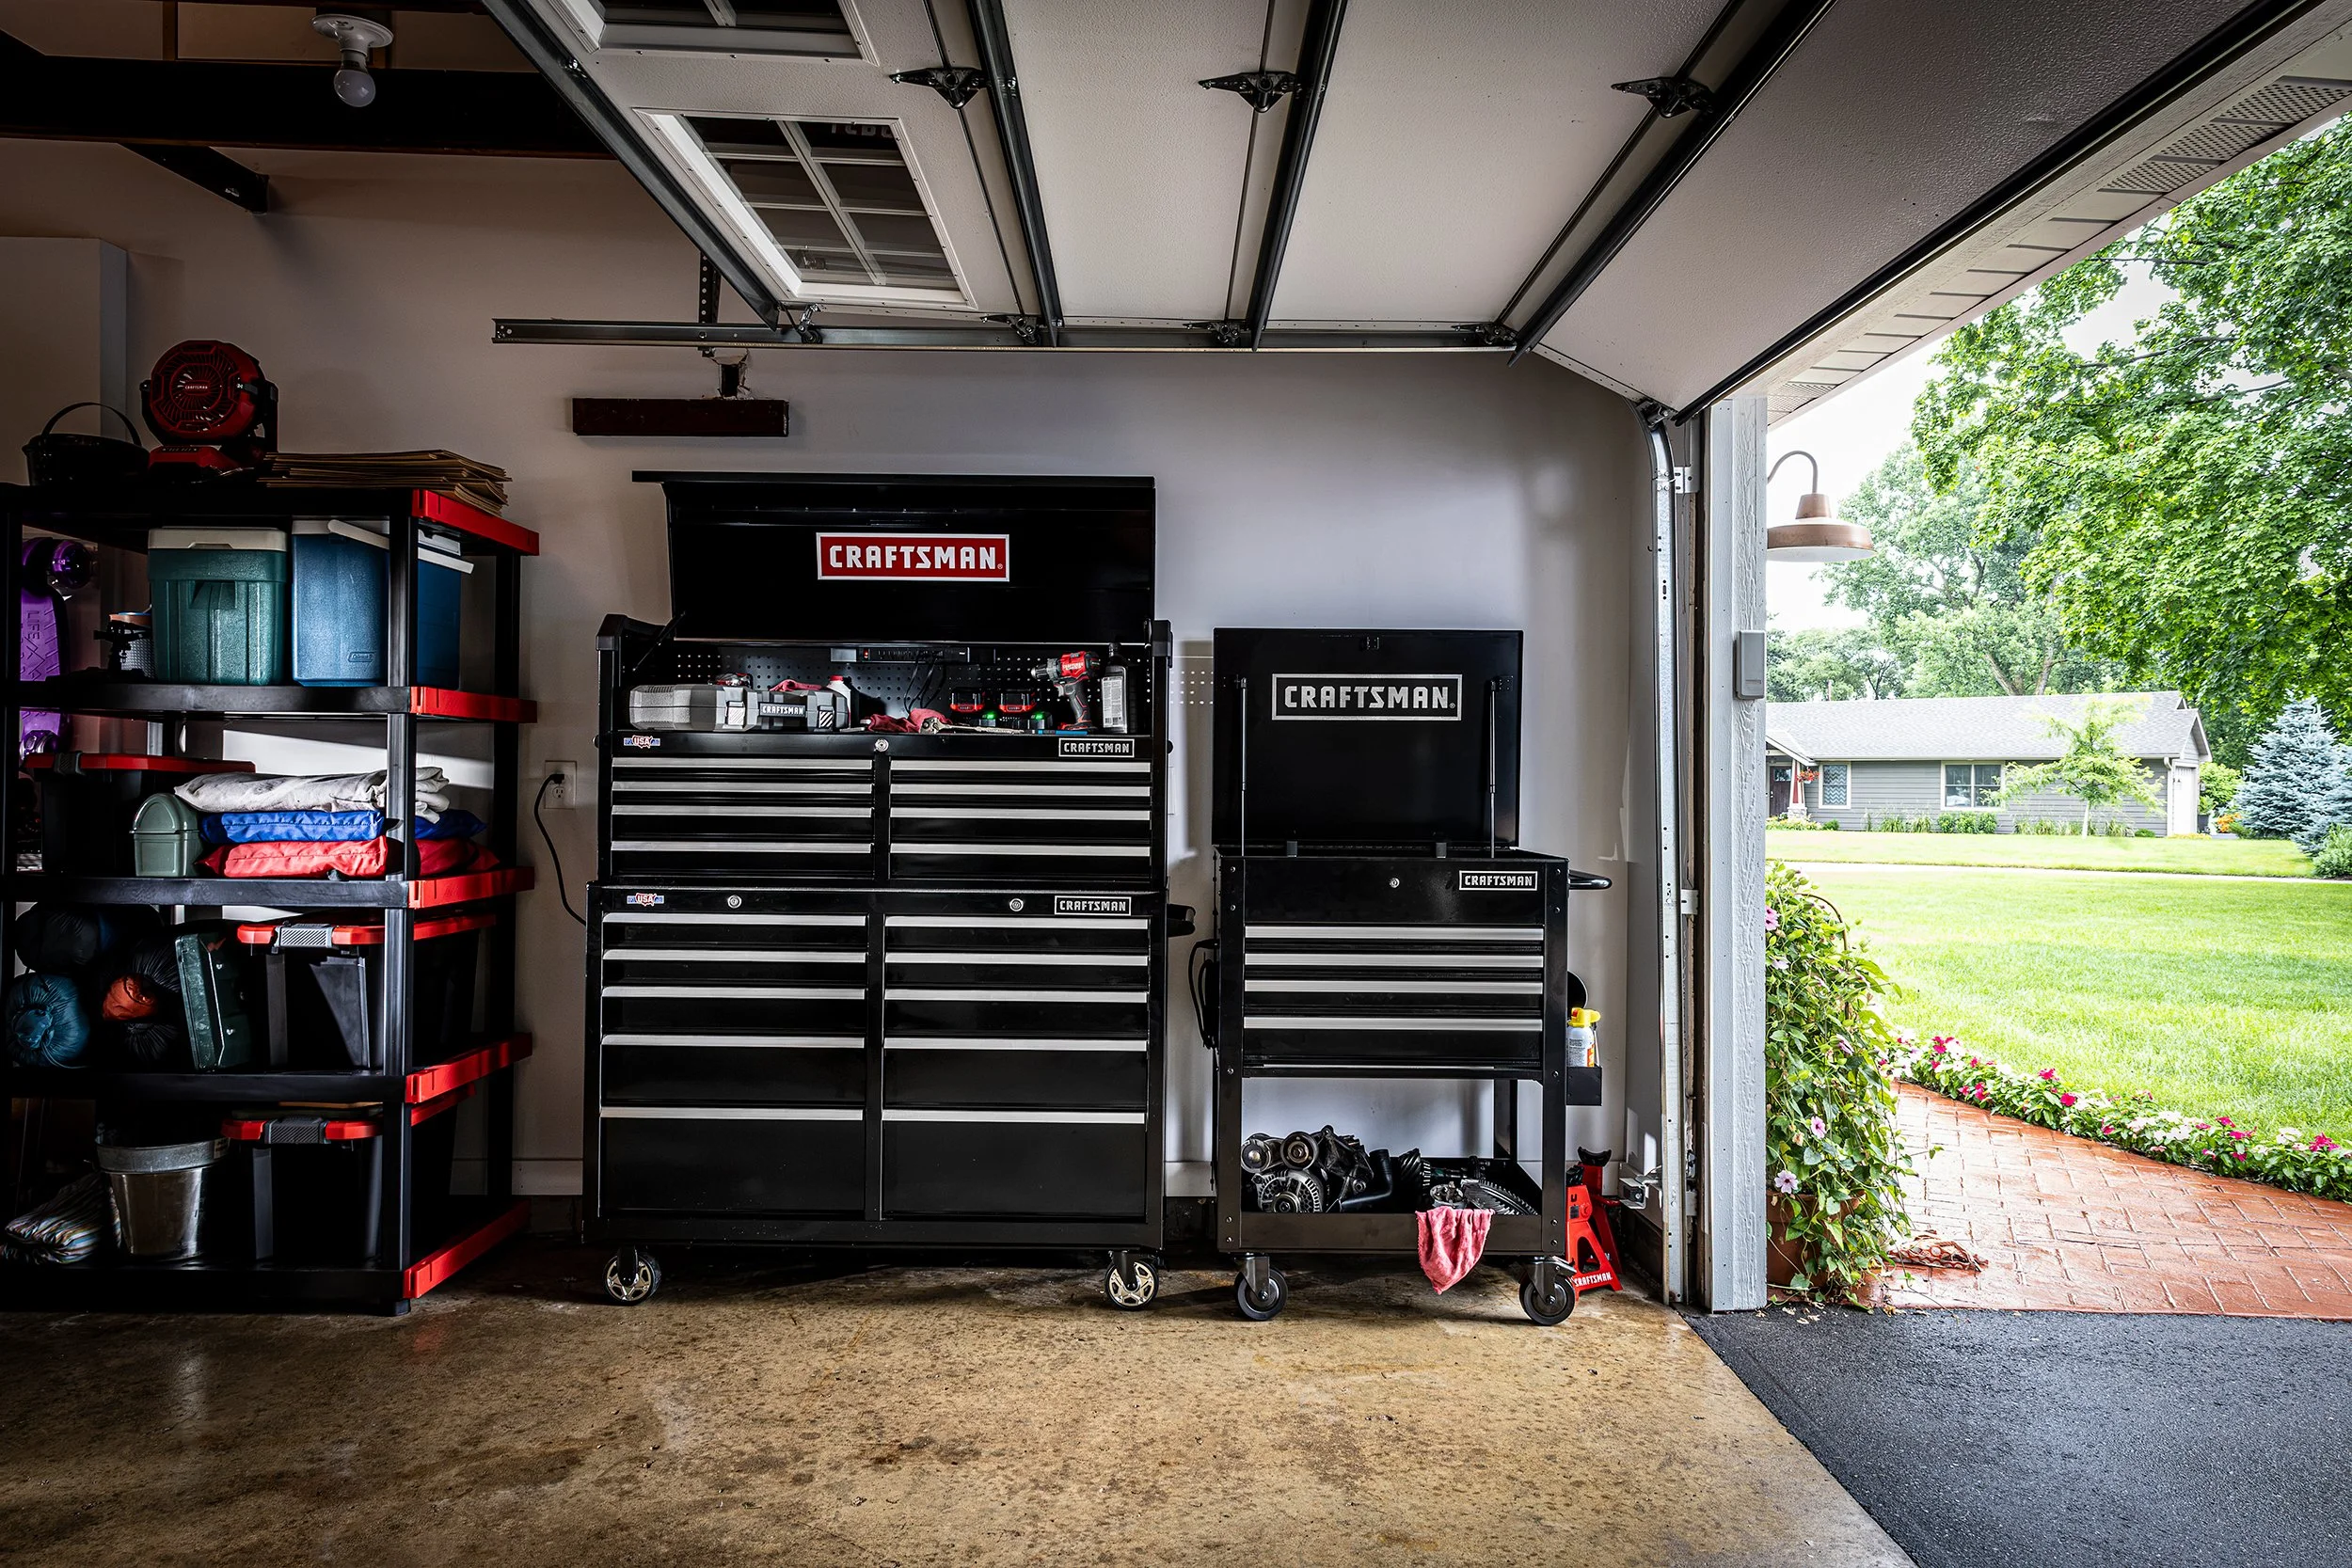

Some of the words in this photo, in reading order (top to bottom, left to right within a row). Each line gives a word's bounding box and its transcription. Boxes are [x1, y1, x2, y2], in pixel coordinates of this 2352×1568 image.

[829, 546, 996, 570] CRAFTSMAN
[1284, 686, 1449, 709] CRAFTSMAN
[762, 705, 803, 715] CRAFTSMAN
[634, 736, 650, 745] USA
[1064, 742, 1130, 753] CRAFTSMAN
[1464, 875, 1533, 886] CRAFTSMAN
[637, 895, 654, 903] USA
[1059, 900, 1126, 911] CRAFTSMAN
